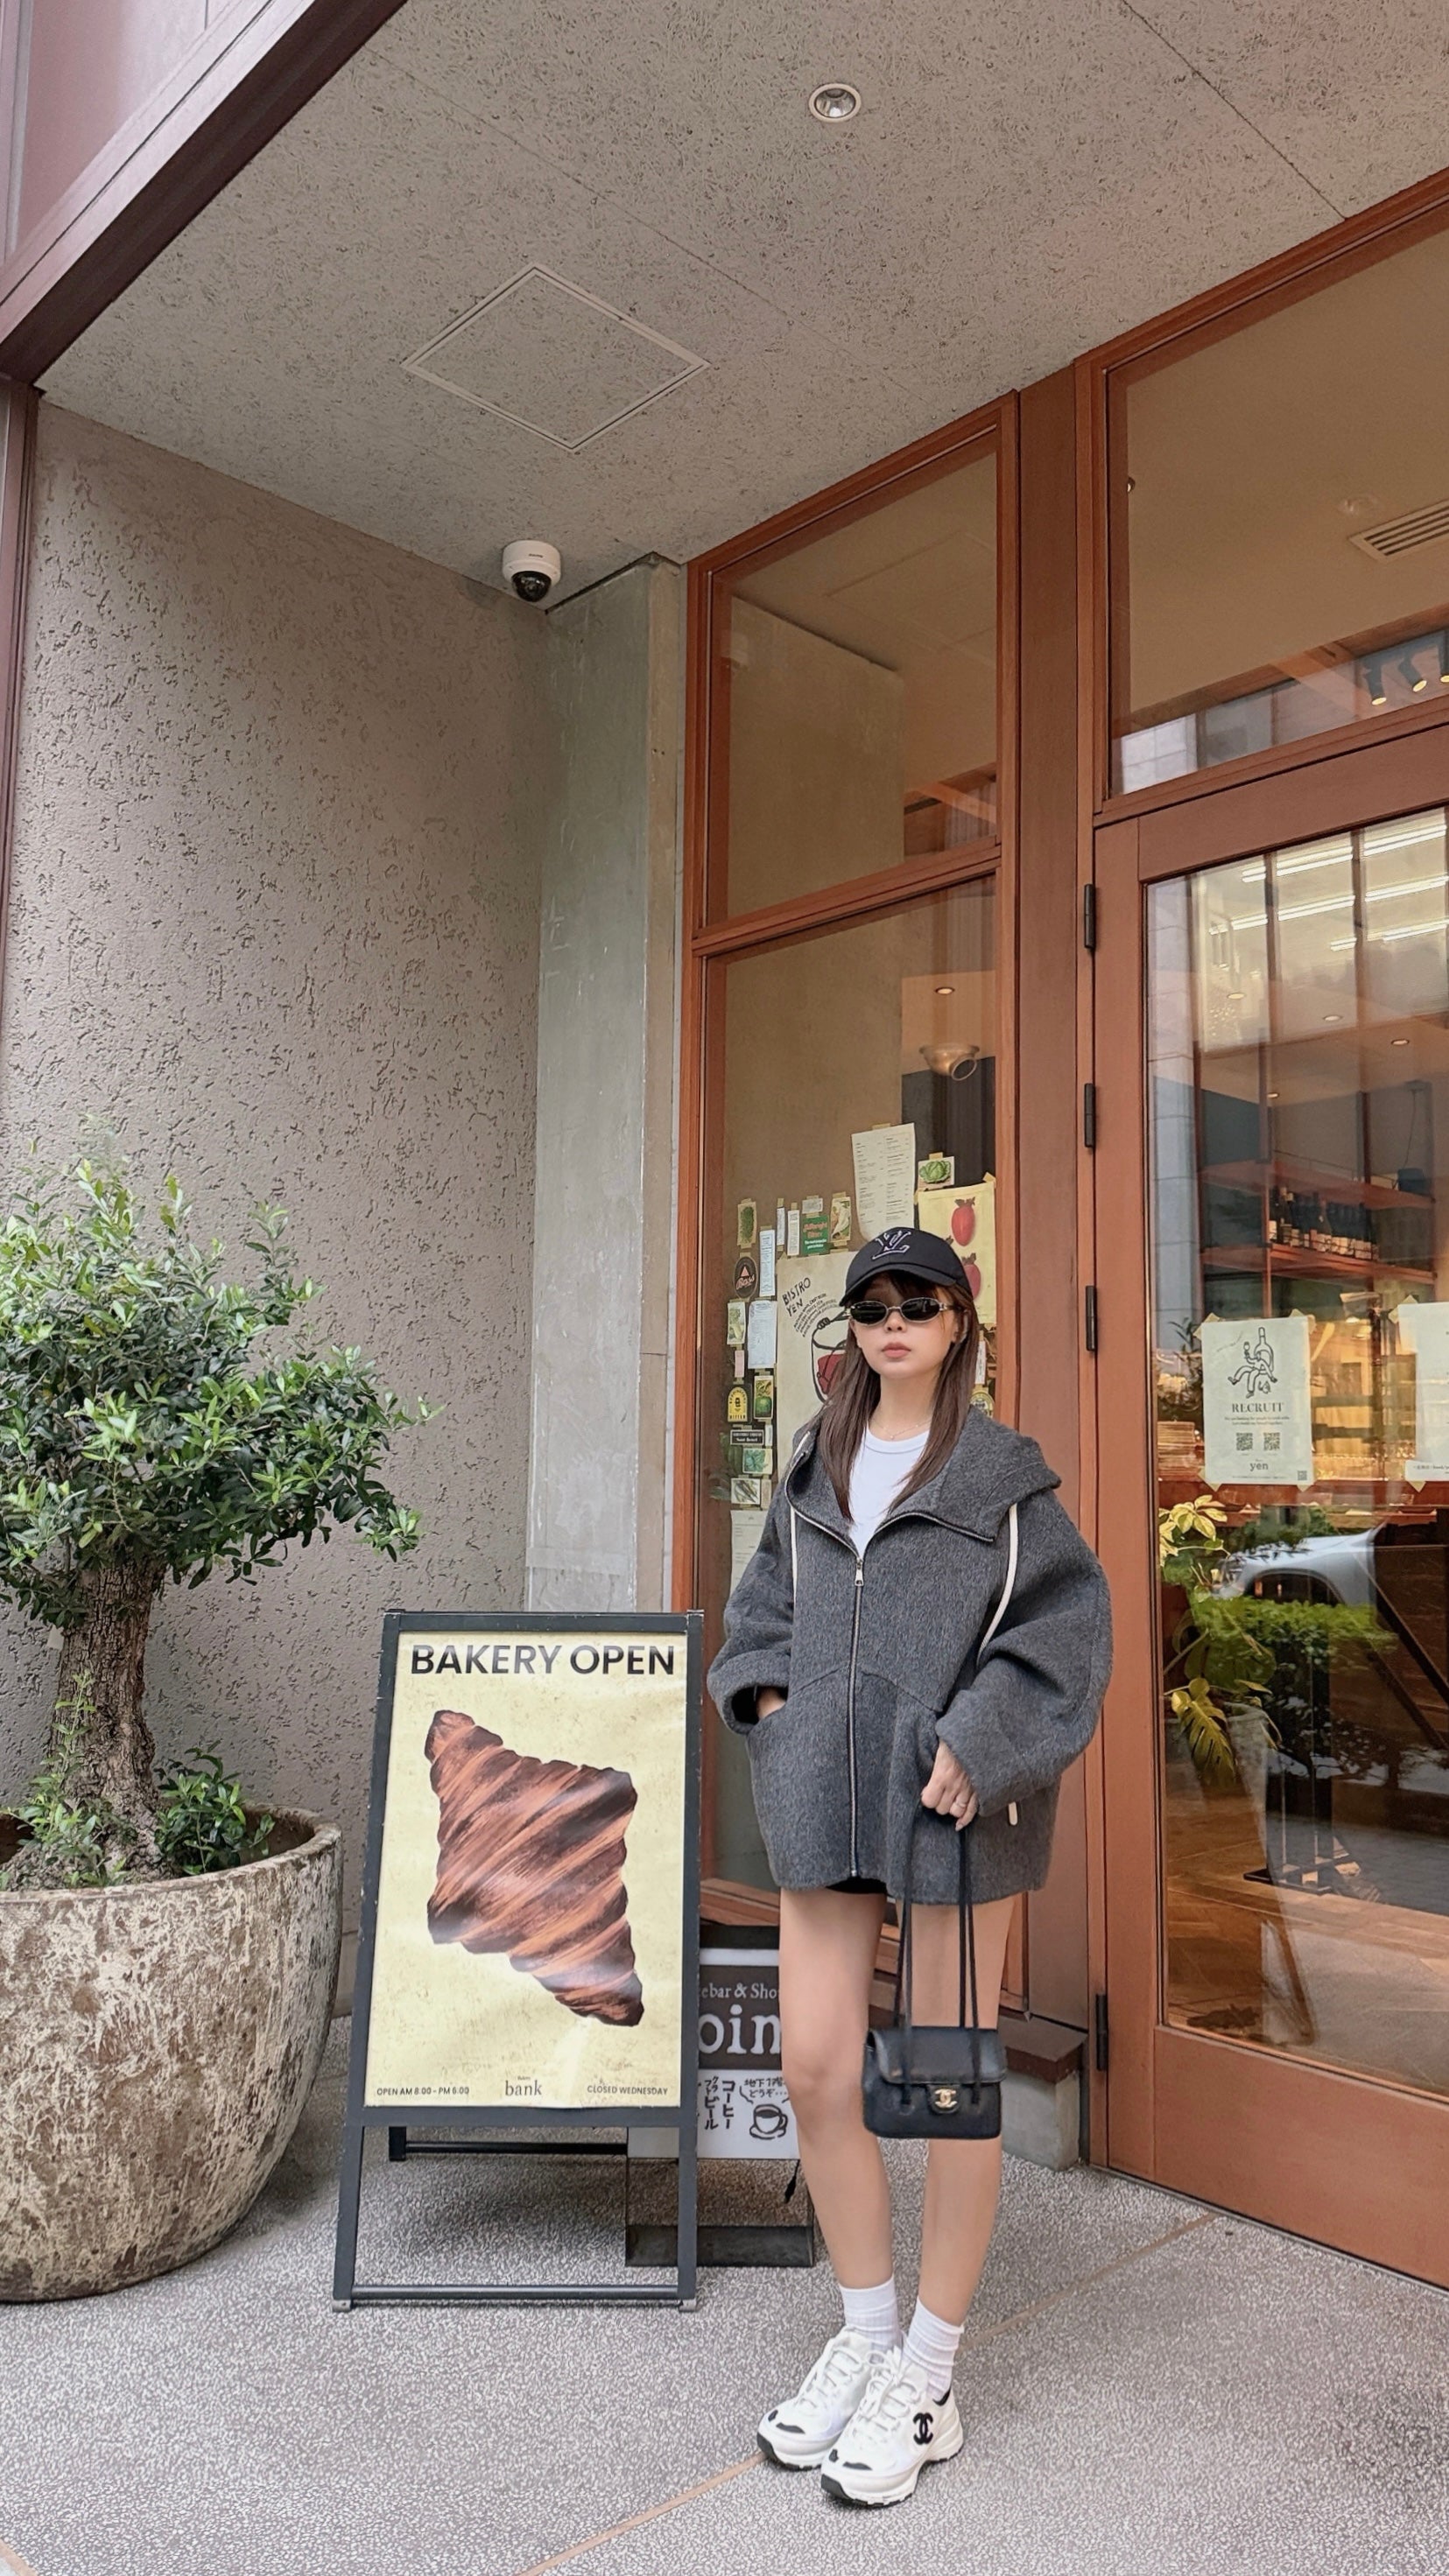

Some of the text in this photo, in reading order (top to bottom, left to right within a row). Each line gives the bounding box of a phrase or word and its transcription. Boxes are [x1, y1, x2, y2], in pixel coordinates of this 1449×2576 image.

[782, 1277, 811, 1306] BISTRO
[786, 1298, 803, 1316] YEN
[1232, 1402, 1284, 1413] RECRUIT
[1249, 1463, 1269, 1471] yen
[411, 1645, 675, 1675] BAKERY OPEN
[701, 1982, 778, 1999] ebar & Sho
[698, 2004, 781, 2054] oin
[504, 2080, 542, 2096] bank
[587, 2085, 668, 2095] CLOSED WEDNESDAY
[722, 2080, 735, 2130] コーヒー
